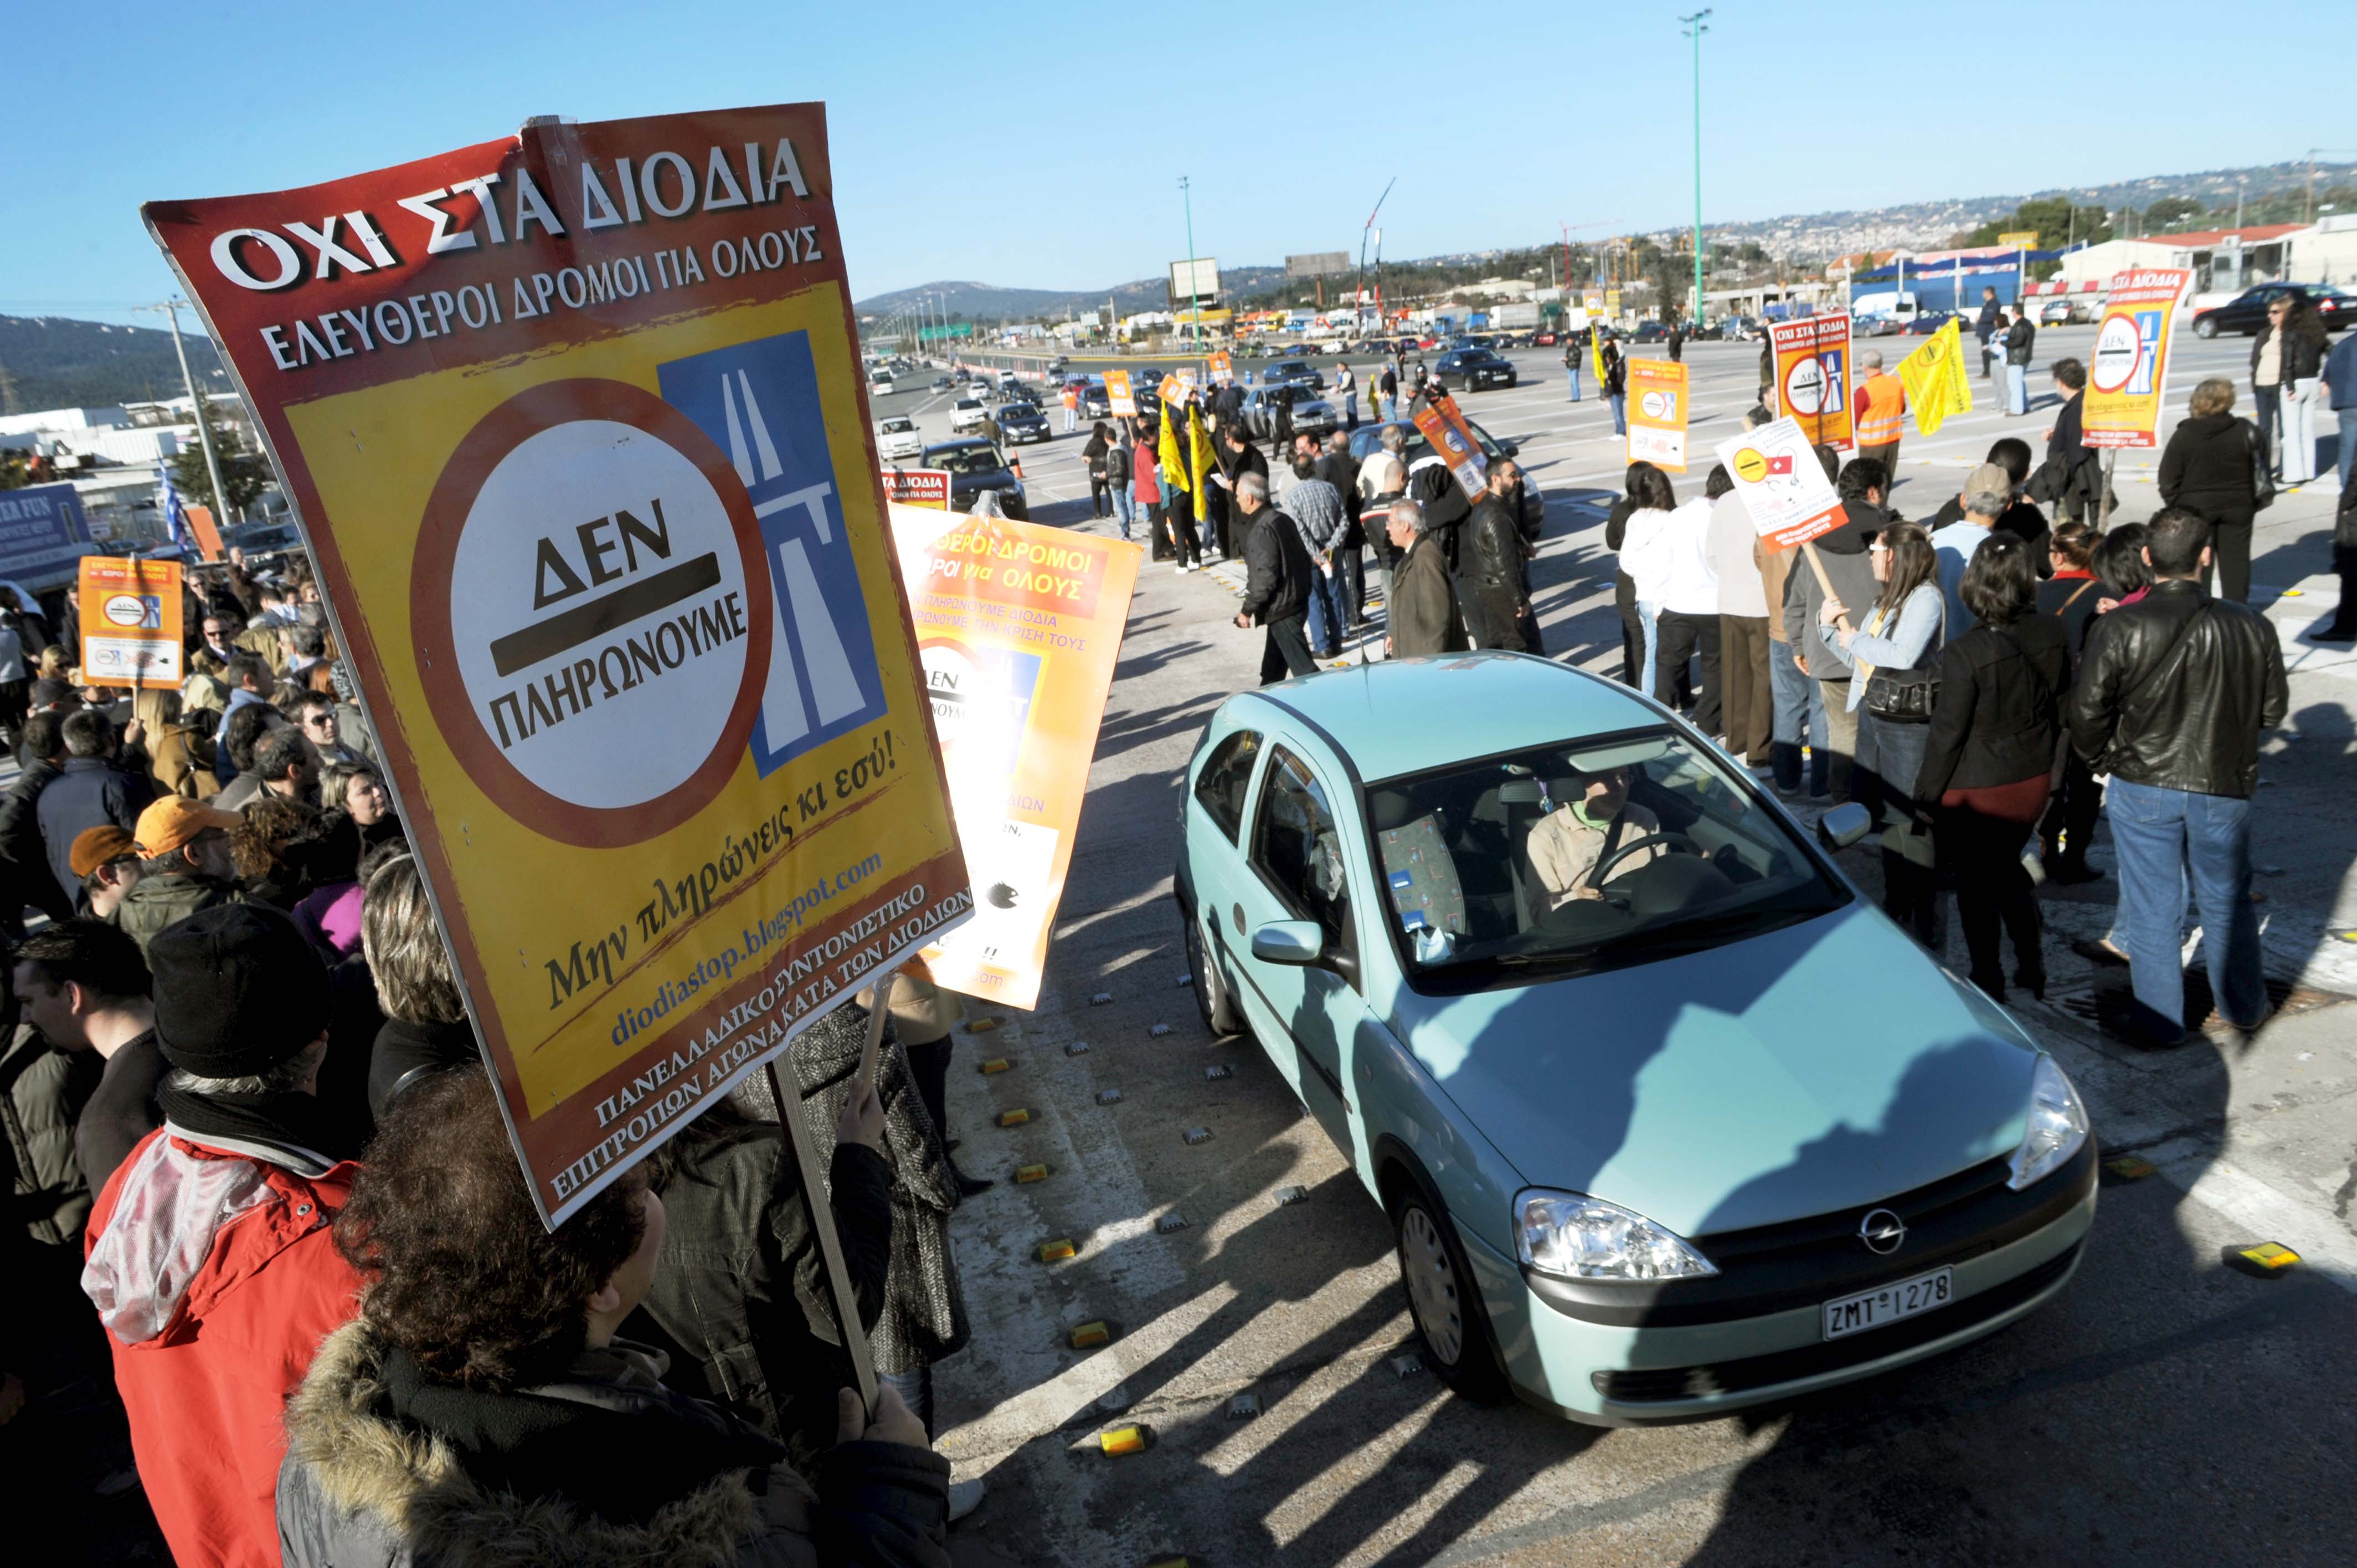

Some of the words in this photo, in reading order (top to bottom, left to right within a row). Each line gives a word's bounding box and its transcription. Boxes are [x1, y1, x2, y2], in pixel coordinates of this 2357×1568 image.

[209, 209, 397, 291] ΟΧΙ
[397, 168, 565, 255] ΣΤΑ
[582, 137, 809, 230] ΔΙΟΔΙΑ
[260, 282, 502, 371] ΕΛΕΥΘΕΡΟΙ
[514, 255, 651, 320] ΔΡΟΜΟΙ
[655, 245, 704, 288] ΓΙΑ
[712, 225, 823, 278] ΟΛΟΥΣ
[1776, 328, 1795, 342] ΟΧΙ
[1796, 326, 1815, 339] ΣΤΑ
[1800, 372, 1818, 383] ΔΕΝ
[882, 476, 896, 488] ΤΑ
[899, 476, 943, 488] ΔΙΟΔΙΑ
[533, 498, 671, 611] ΔΕΝ
[935, 533, 994, 556] ΘΕΡΟΙ
[997, 540, 1092, 574] ΔΡΟΜΟΙ
[963, 563, 994, 580] για
[1002, 568, 1083, 600] ΟΛΟΥΣ
[924, 595, 1006, 617] ΠΛΗΡΩΝΟΥΜΕ
[1008, 608, 1058, 628] ΔΙΟΔΙΑ
[974, 618, 1000, 633] ΤΗΝ
[1003, 625, 1045, 643] ΚΡΙΣΗ
[1049, 633, 1087, 651] ΤΟΥΣ
[488, 591, 747, 750] ΠΛΗΡΩΝΟΥΜΕ
[1007, 794, 1045, 813] ΔΙΩΝ
[543, 924, 628, 1011] Μην
[636, 804, 794, 945] πληρώνεις
[796, 787, 828, 824] κι
[836, 730, 896, 799] εσύ!
[610, 852, 884, 1047] diodiastop.blogspot.com
[594, 983, 774, 1129] ΠΑΝΕΛΛΑΔΙΚΟ
[774, 883, 925, 998] ΣΥΝΤΟΝΙΣΤΙΚΟ
[549, 1073, 702, 1203] ΕΠΙΤΡΟΠΩΝ
[708, 1019, 783, 1089] ΑΓΩΝΑ
[781, 979, 838, 1028] ΚΑΤΑ
[837, 947, 883, 986] ΤΩΝ
[887, 886, 974, 953] ΔΙΟΔΙΩΝ
[1895, 1275, 1948, 1314] 1278
